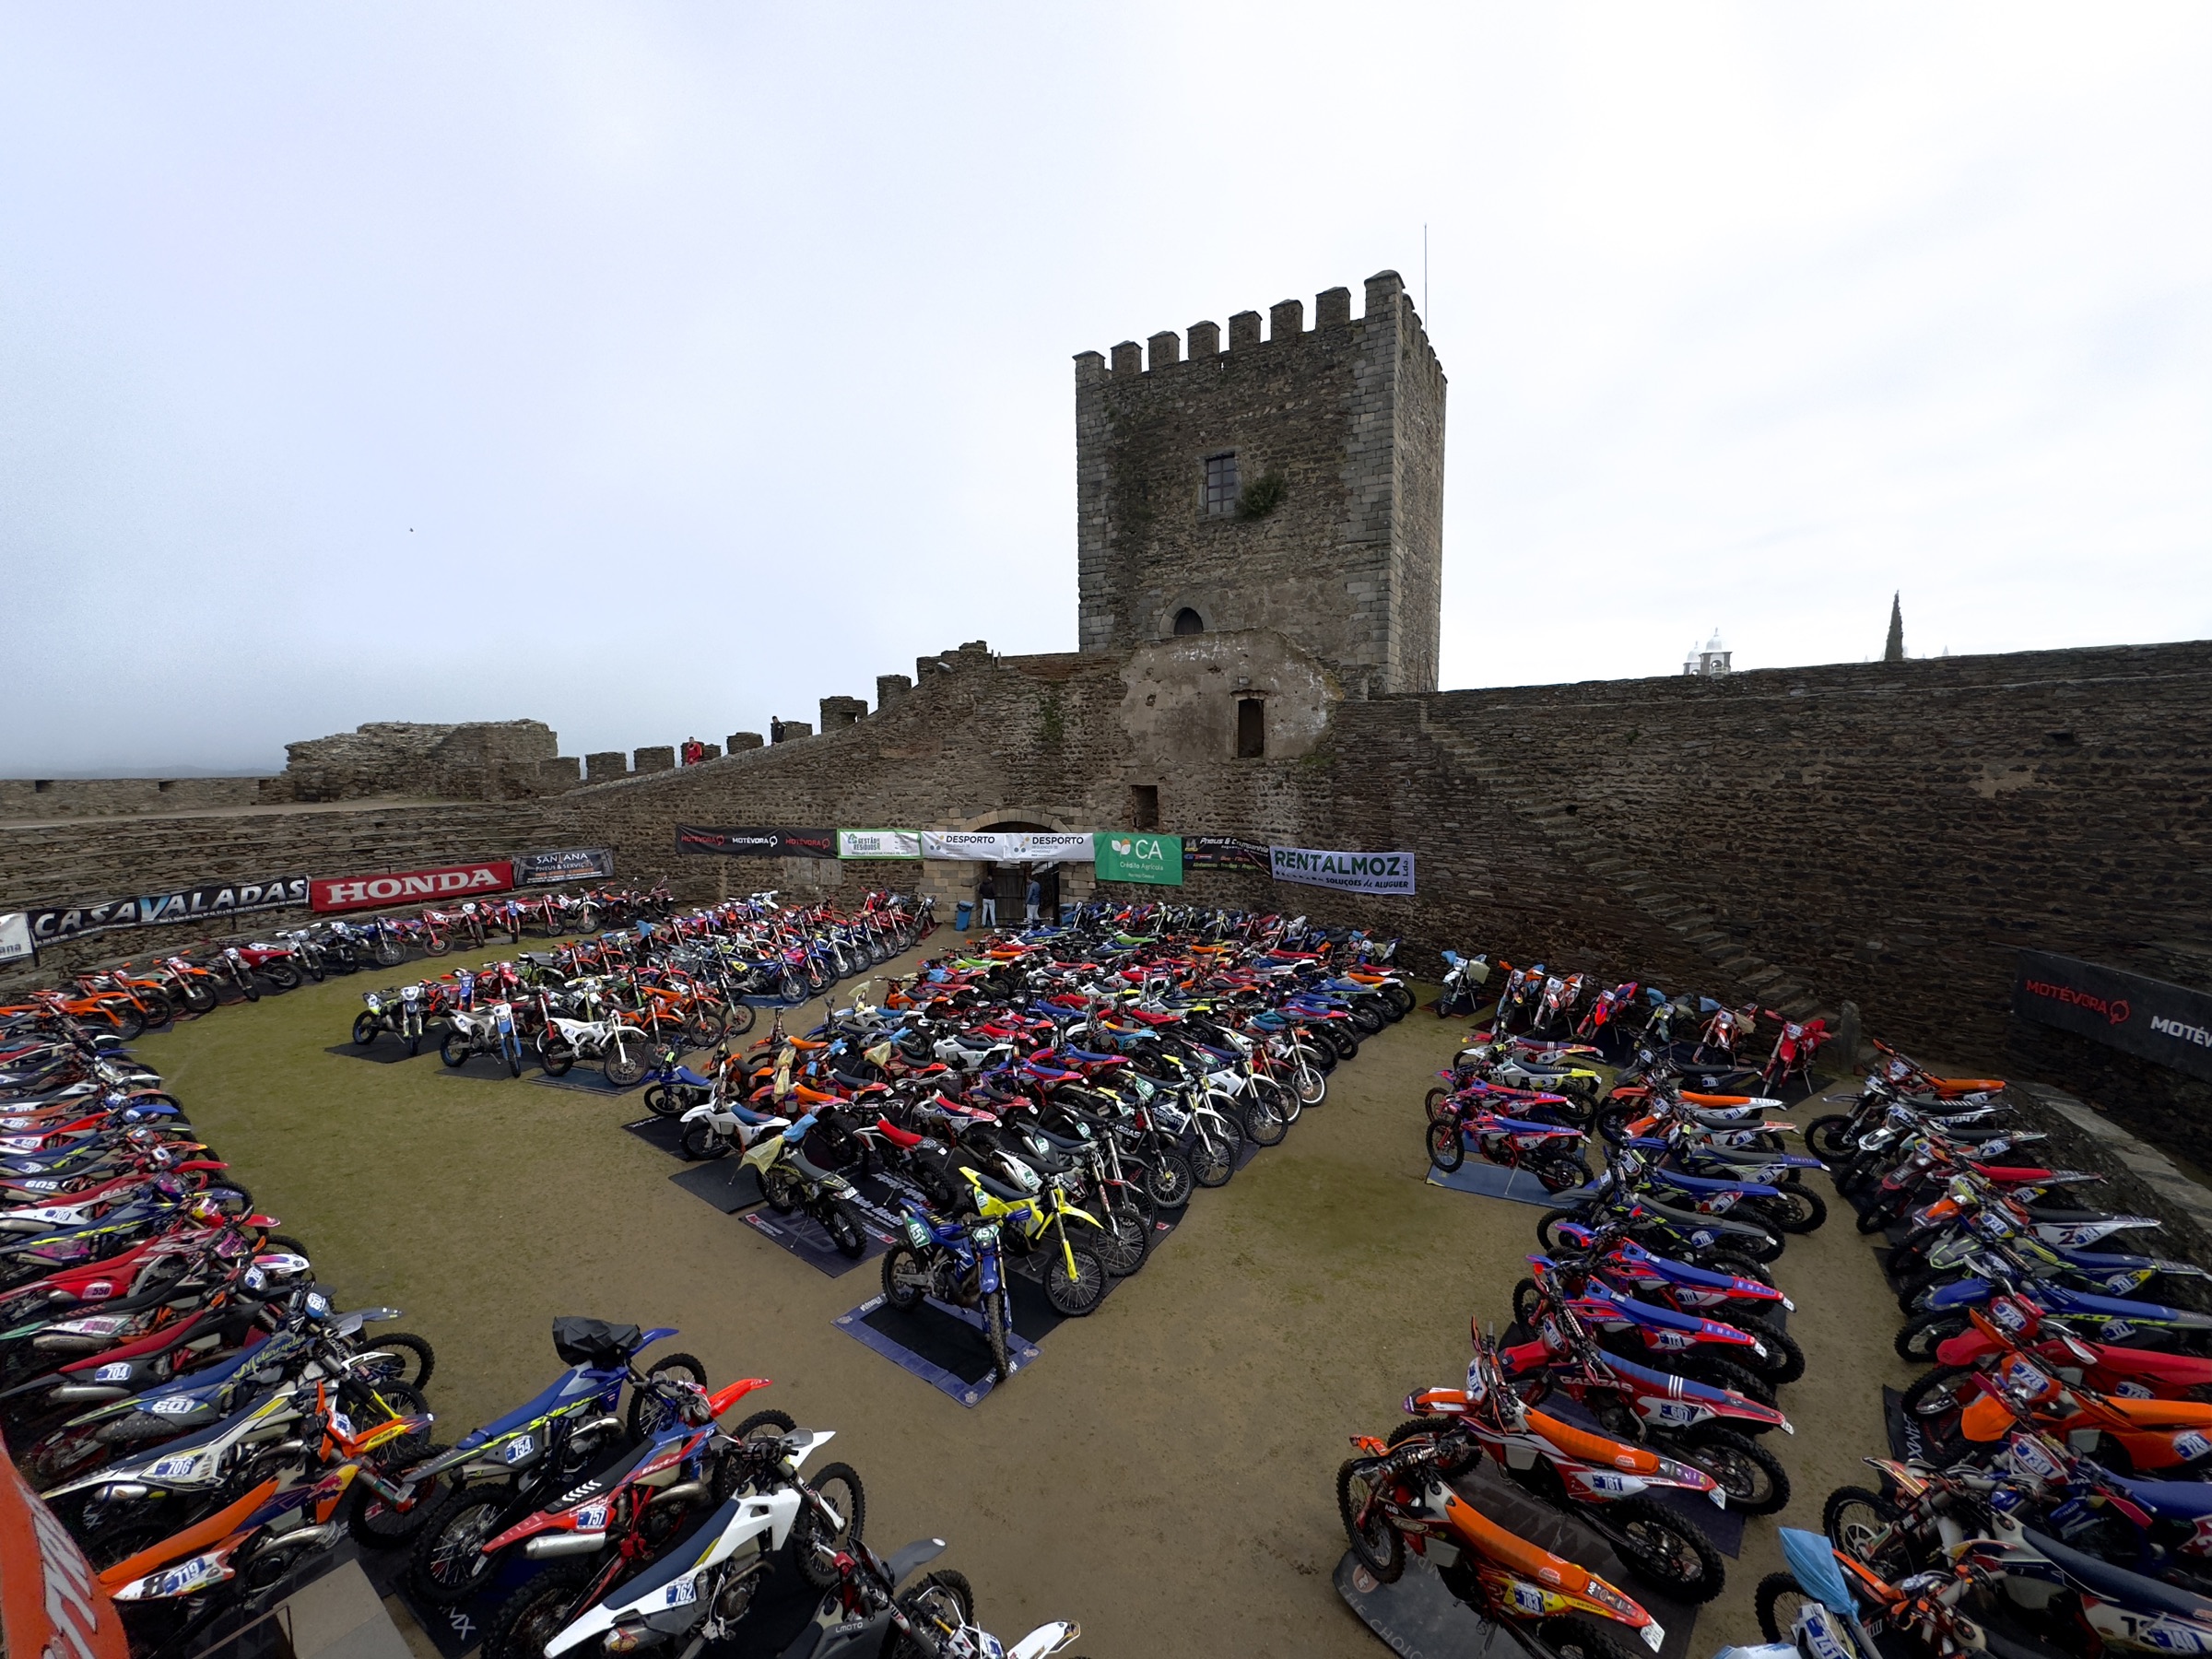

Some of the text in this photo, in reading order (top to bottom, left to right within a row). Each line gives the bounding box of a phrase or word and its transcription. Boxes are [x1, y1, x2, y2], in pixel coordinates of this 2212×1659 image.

[785, 838, 821, 846] MOTÉVORA
[946, 835, 995, 844] DESPORTO
[1032, 836, 1084, 845] DESPORTO
[1200, 837, 1223, 845] Pneus
[1135, 839, 1163, 860] CA
[536, 853, 588, 864] SANTANA
[1120, 861, 1164, 871] Crédito Agrícola
[1275, 850, 1400, 876] RENTALMOZ
[326, 868, 500, 904] HONDA
[1325, 877, 1362, 887] SOLUÇÕES
[2026, 979, 2108, 1015] MOTÉVORA
[24, 1181, 59, 1190] 605
[53, 1210, 71, 1221] 700
[850, 1194, 904, 1227] Moto-Master
[909, 1223, 925, 1244] 451
[976, 1228, 994, 1240] 451
[2001, 1306, 2022, 1329] 726
[107, 1367, 128, 1379] 704
[2020, 1366, 2043, 1392] 728
[1559, 1375, 1633, 1393] GASGAS
[151, 1401, 195, 1414] 601
[1670, 1406, 1689, 1421] 607
[513, 1441, 532, 1458] 754
[2186, 1436, 2206, 1455] 728
[167, 1460, 193, 1475] 706
[641, 1454, 681, 1475] Beta
[2027, 1451, 2051, 1475] 730
[1604, 1477, 1619, 1490] 781
[588, 1510, 605, 1525] 757
[178, 1560, 200, 1585] 719
[675, 1583, 692, 1604] 762
[1338, 1582, 1367, 1615] THE
[1523, 1591, 1540, 1611] 783
[835, 1622, 864, 1633] LMOTO
